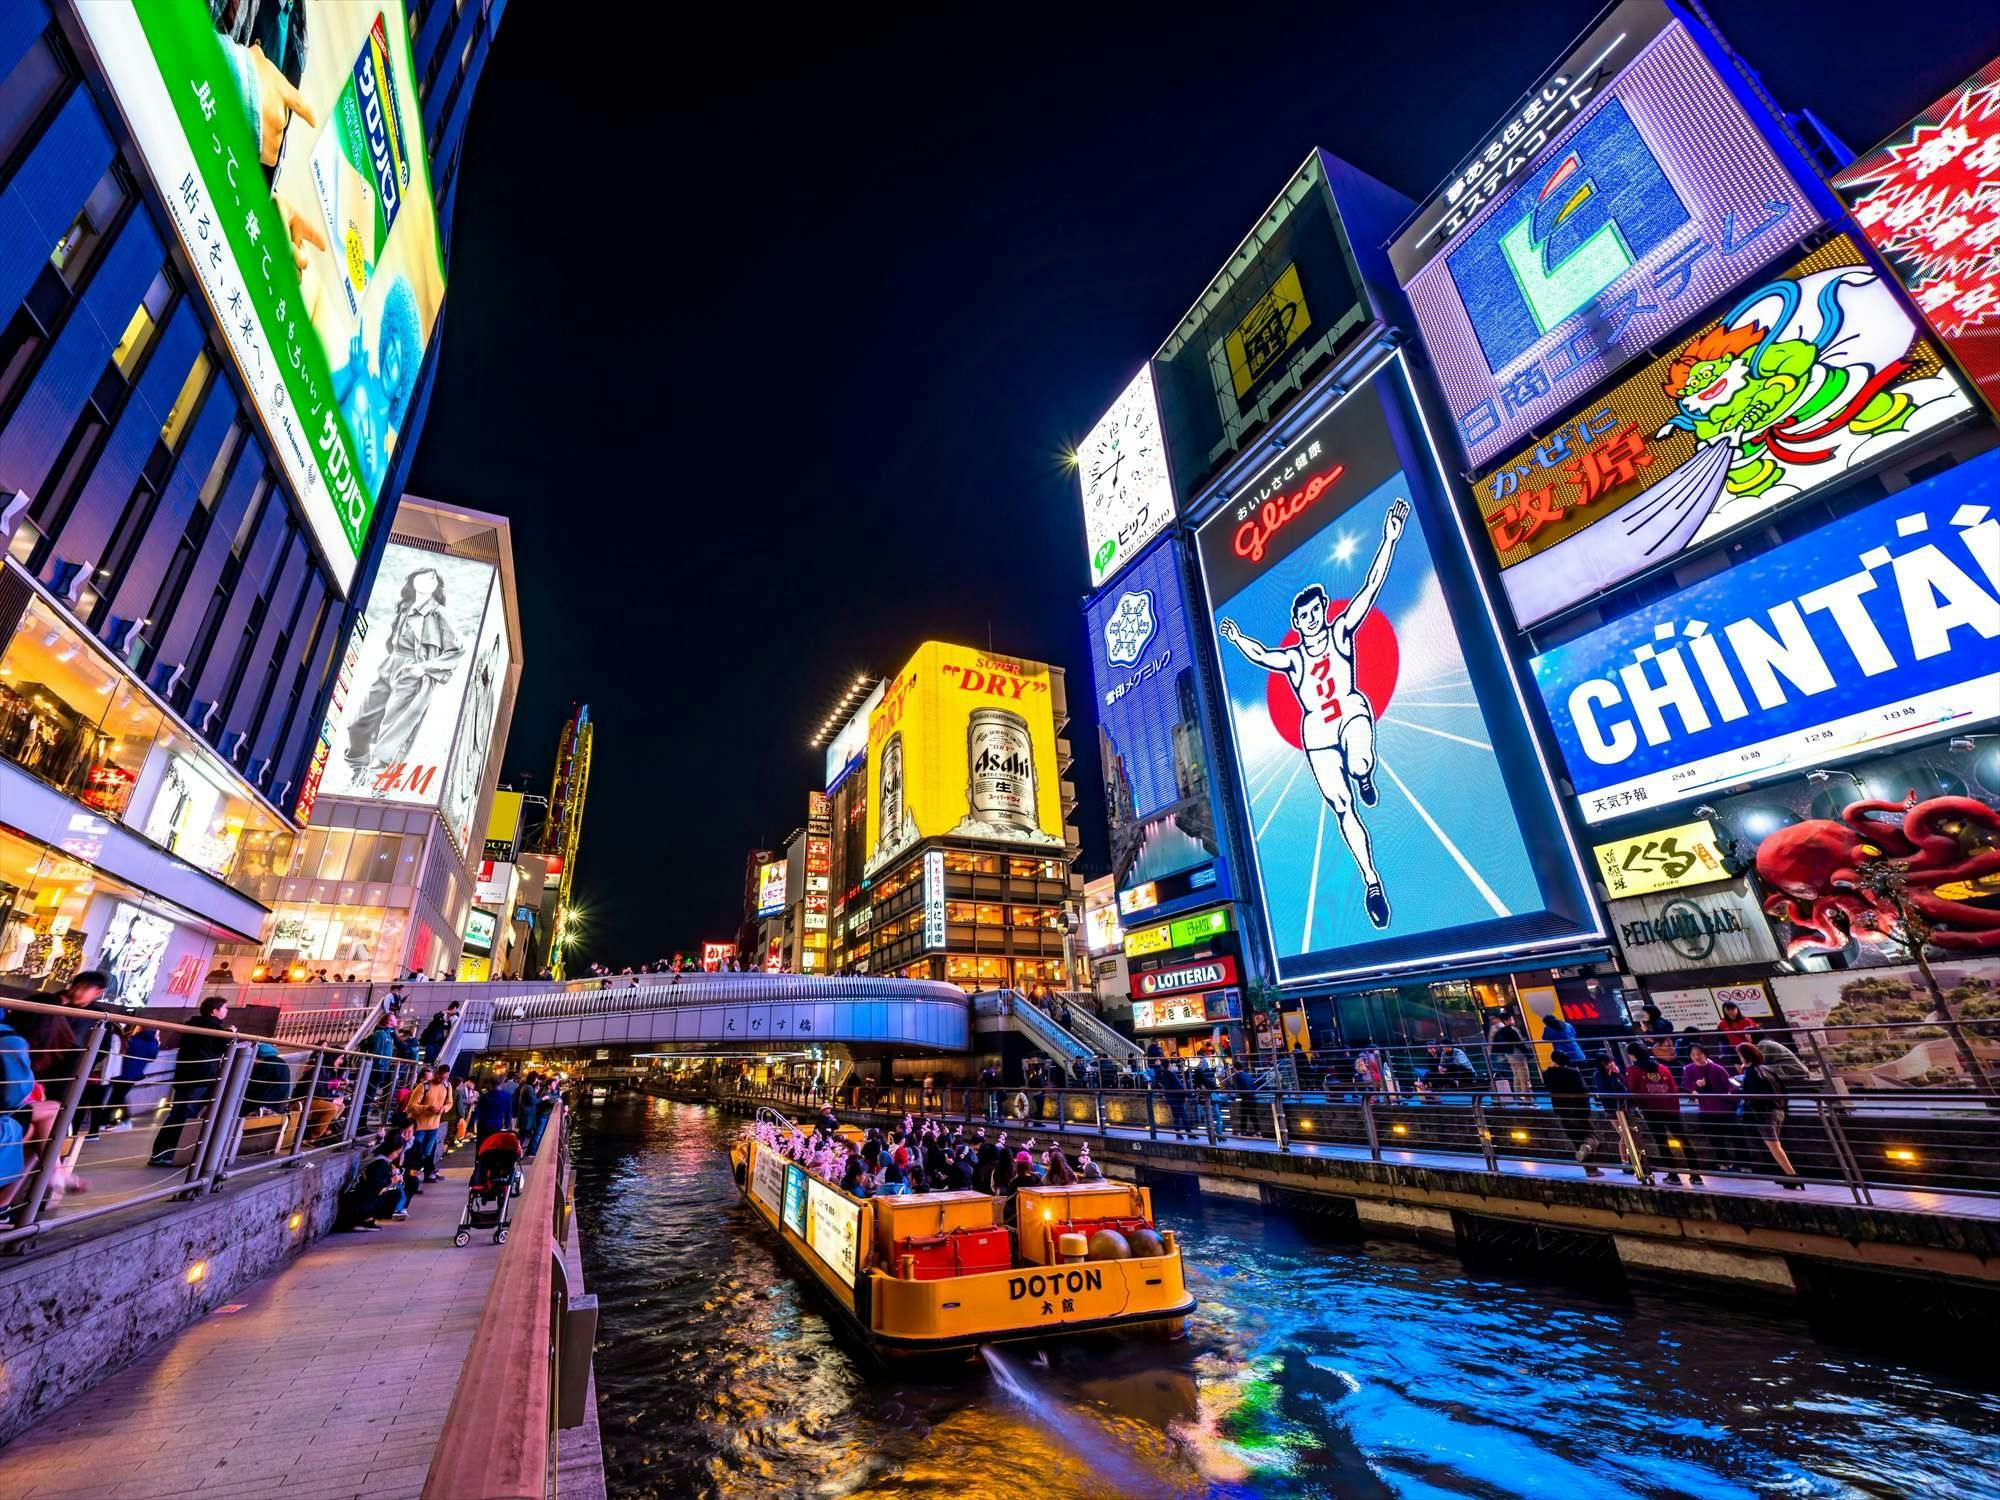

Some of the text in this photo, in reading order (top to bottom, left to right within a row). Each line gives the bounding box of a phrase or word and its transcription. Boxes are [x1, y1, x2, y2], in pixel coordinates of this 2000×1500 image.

[359, 56, 396, 226] サロンパス
[1488, 406, 1618, 500] かぜに
[319, 409, 366, 540] サロンパス
[1238, 440, 1322, 520] おいしさと健康
[1486, 421, 1655, 551] 改源
[1117, 502, 1150, 546] ピップ
[976, 657, 1021, 675] SUPER
[1310, 652, 1342, 723] グリコ
[1881, 706, 1917, 721] 18時
[1803, 729, 1834, 744] 12時
[373, 761, 437, 795] H&M
[975, 748, 1029, 779] Asahi
[996, 781, 1012, 793] 生
[1593, 785, 1649, 814] 天気予報
[1622, 838, 1696, 878] くくる
[1157, 966, 1217, 989] LOTTERIA
[727, 1018, 812, 1032] えびす橋
[1008, 1269, 1102, 1300] DOTON
[1041, 1299, 1074, 1315] 大阪
